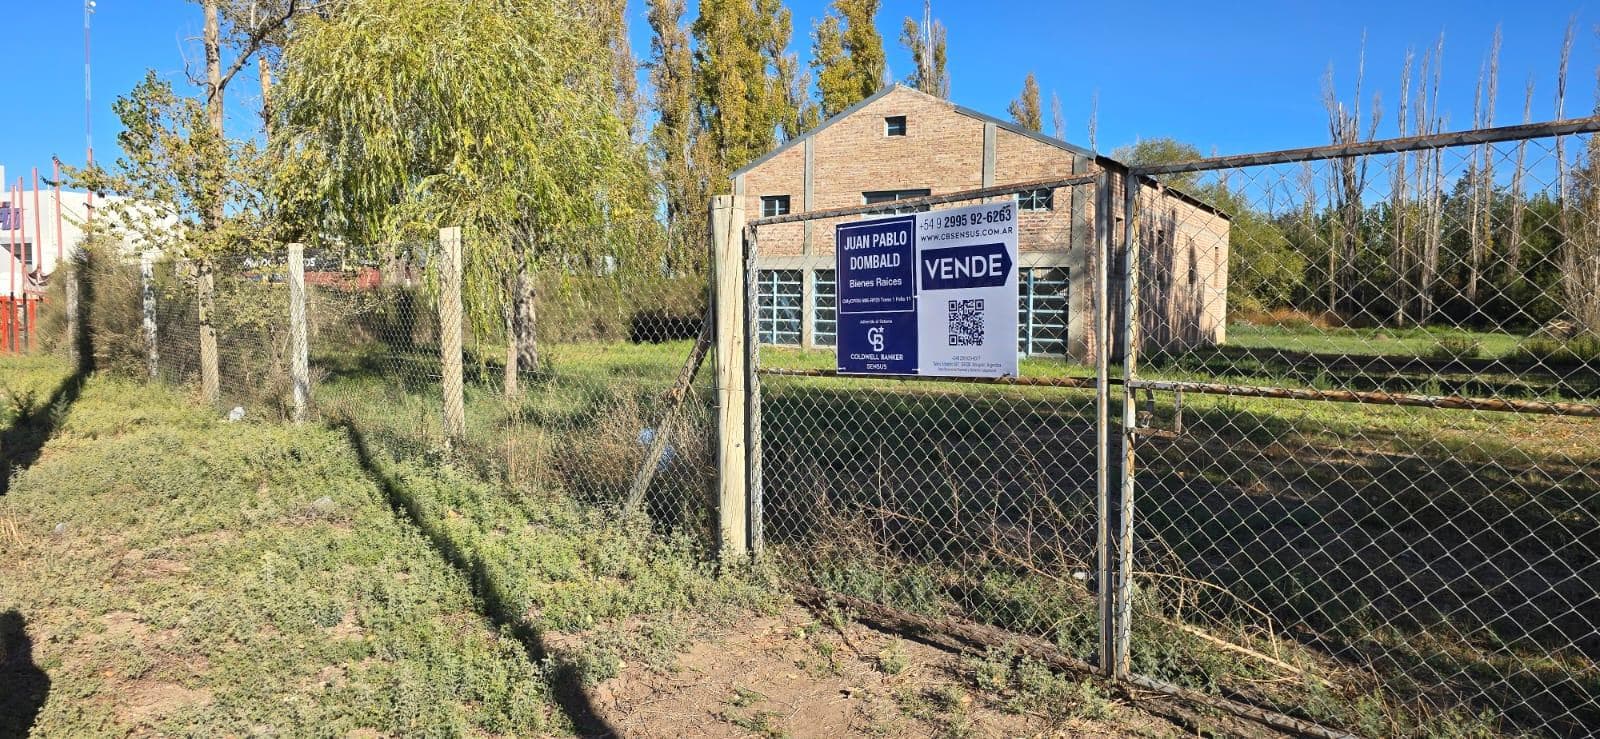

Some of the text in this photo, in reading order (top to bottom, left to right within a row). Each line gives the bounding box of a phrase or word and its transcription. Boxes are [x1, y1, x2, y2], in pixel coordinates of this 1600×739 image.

[937, 218, 942, 228] 9
[945, 215, 967, 228] 2995
[971, 209, 1011, 225] 92-6263
[844, 231, 907, 250] JUAN PABLO
[921, 227, 1013, 242] WWW.CBSENSUS.COM.AR
[850, 253, 900, 270] DOMBALD
[925, 254, 1002, 279] VENDE
[850, 279, 874, 288] Bienes
[851, 353, 903, 361] COLDWELL BANKER
